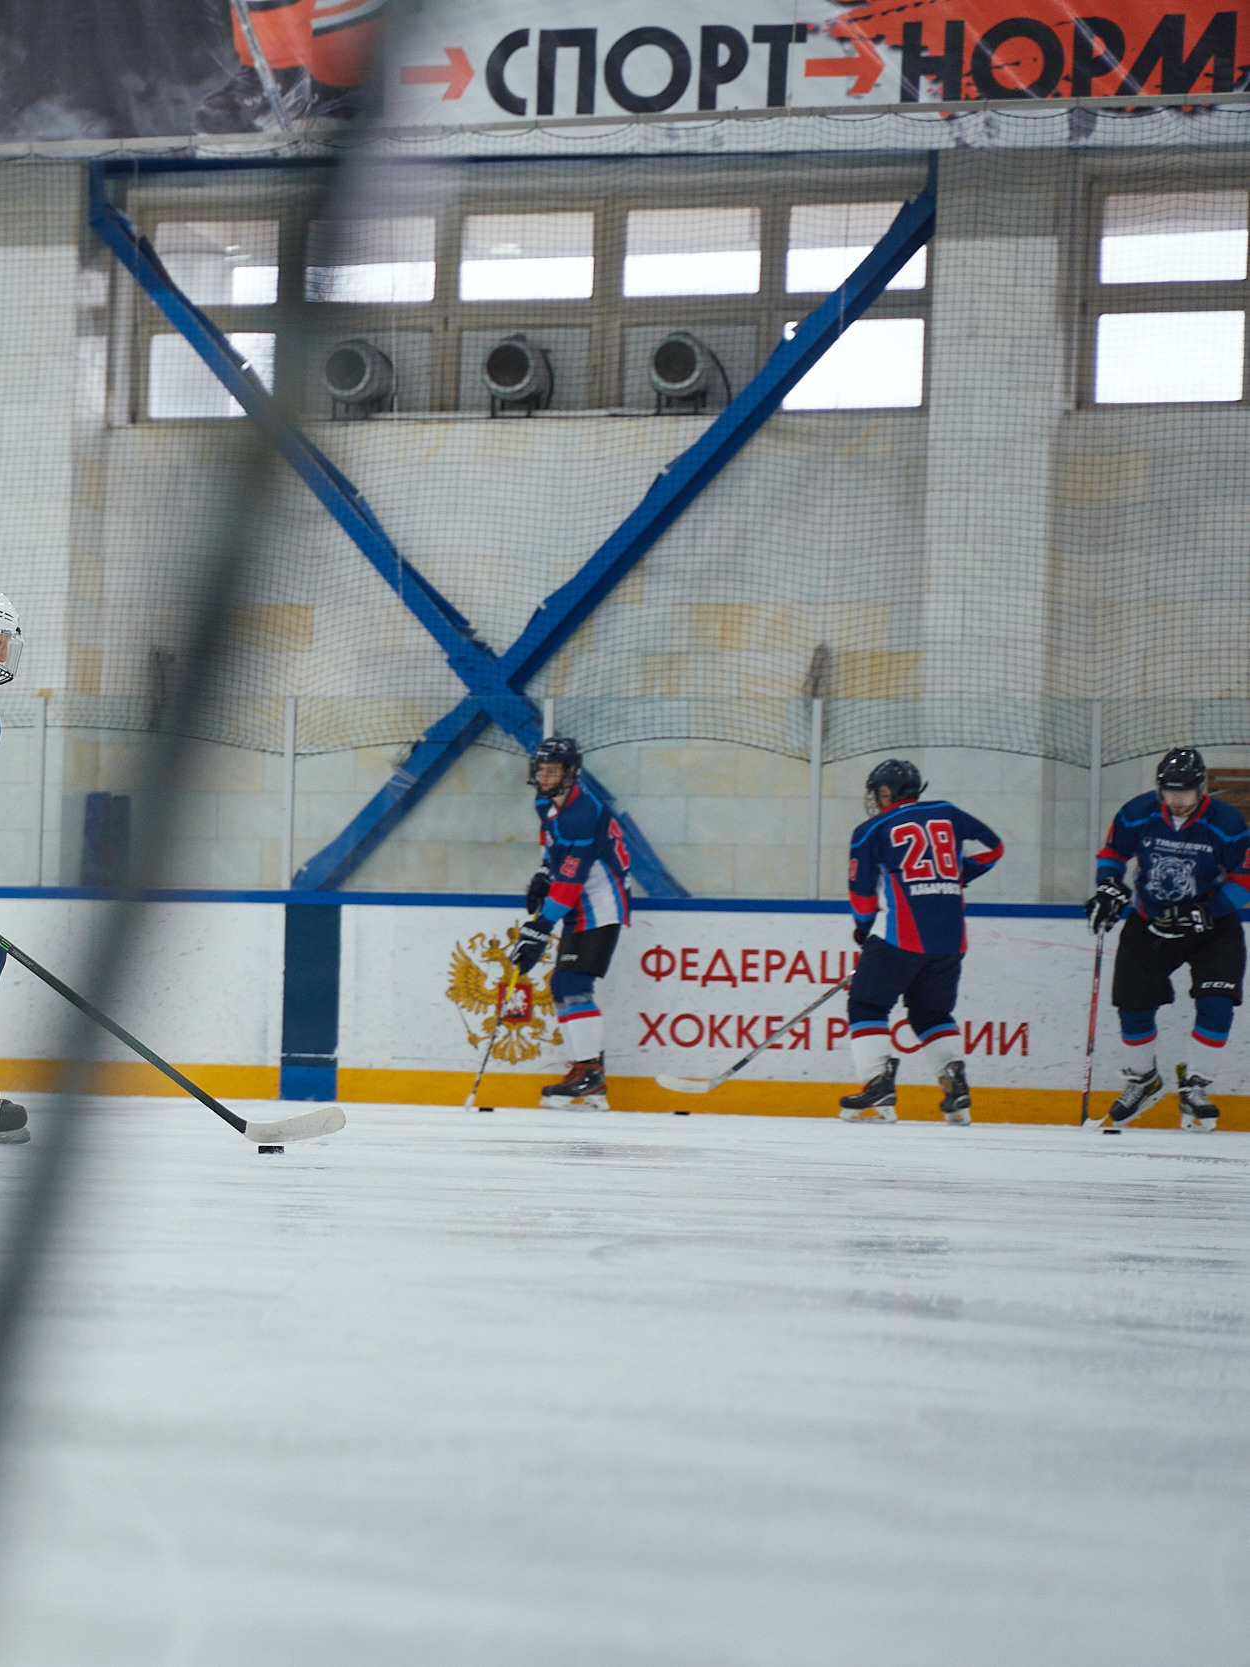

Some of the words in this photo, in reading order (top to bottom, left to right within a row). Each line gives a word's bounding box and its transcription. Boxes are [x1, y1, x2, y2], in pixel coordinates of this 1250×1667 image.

[486, 24, 807, 116] СПОРТ
[890, 819, 960, 883] 28
[1201, 981, 1236, 990] CCM
[638, 1012, 810, 1051] ХОККЕЯ
[826, 1016, 1029, 1057] РСИИ
